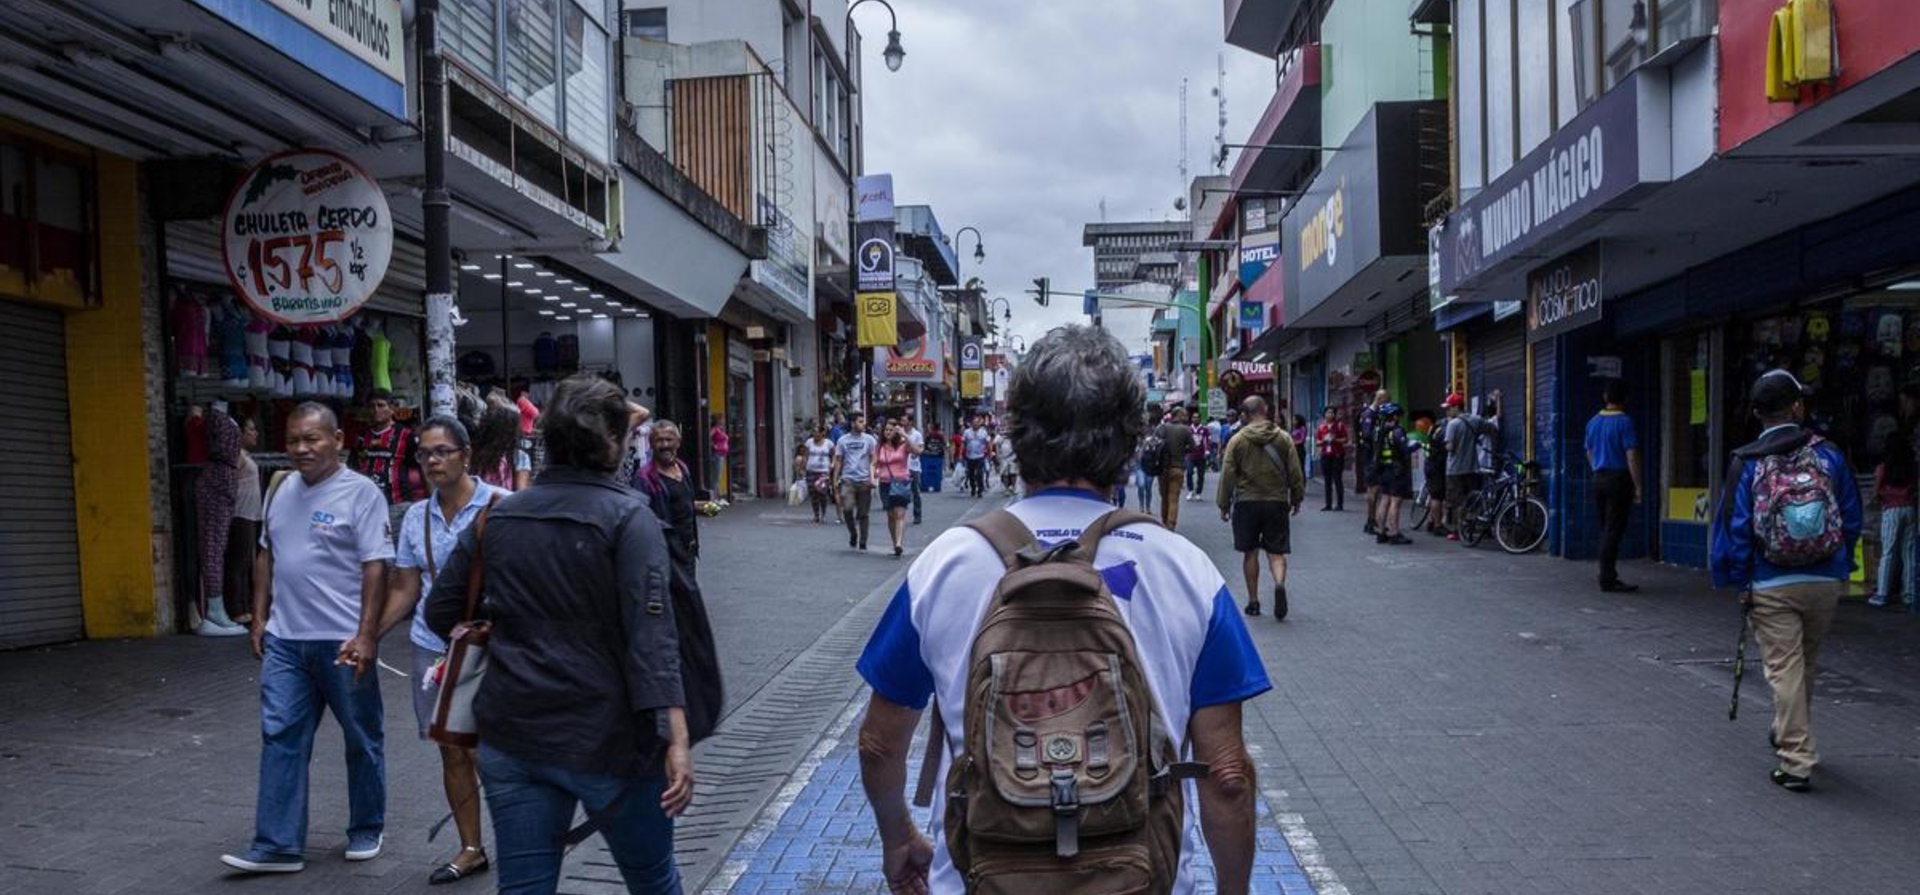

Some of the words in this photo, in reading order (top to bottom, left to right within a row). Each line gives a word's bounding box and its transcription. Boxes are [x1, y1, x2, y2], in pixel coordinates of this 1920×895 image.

[1481, 179, 1530, 258] MUNDO
[1533, 125, 1603, 227] MÁGICO
[318, 205, 377, 231] CERDO
[1241, 247, 1277, 262] HOTEL
